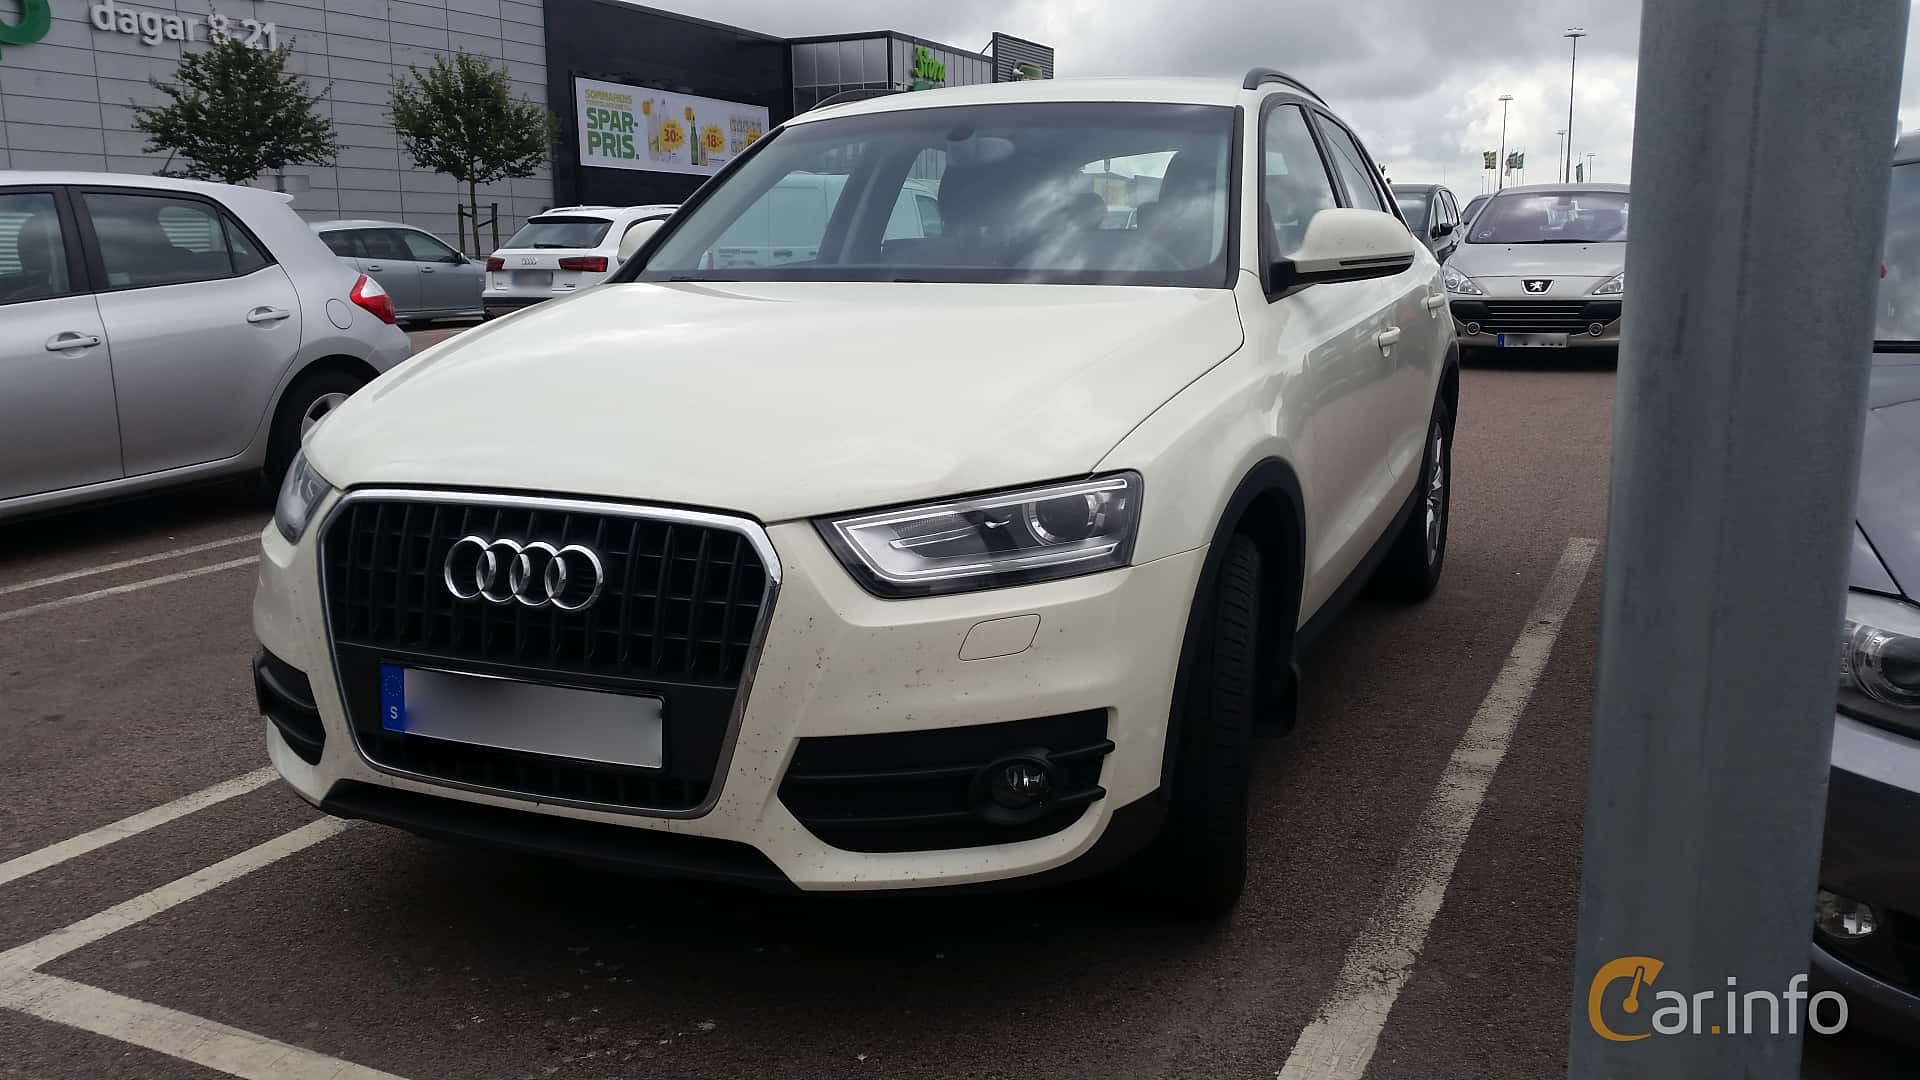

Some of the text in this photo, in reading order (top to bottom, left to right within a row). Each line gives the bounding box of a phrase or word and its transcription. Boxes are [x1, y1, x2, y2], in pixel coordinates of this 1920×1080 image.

[90, 0, 199, 46] dagar
[586, 107, 639, 134] SPAR-
[587, 130, 640, 160] PRIS.
[390, 706, 398, 720] S
